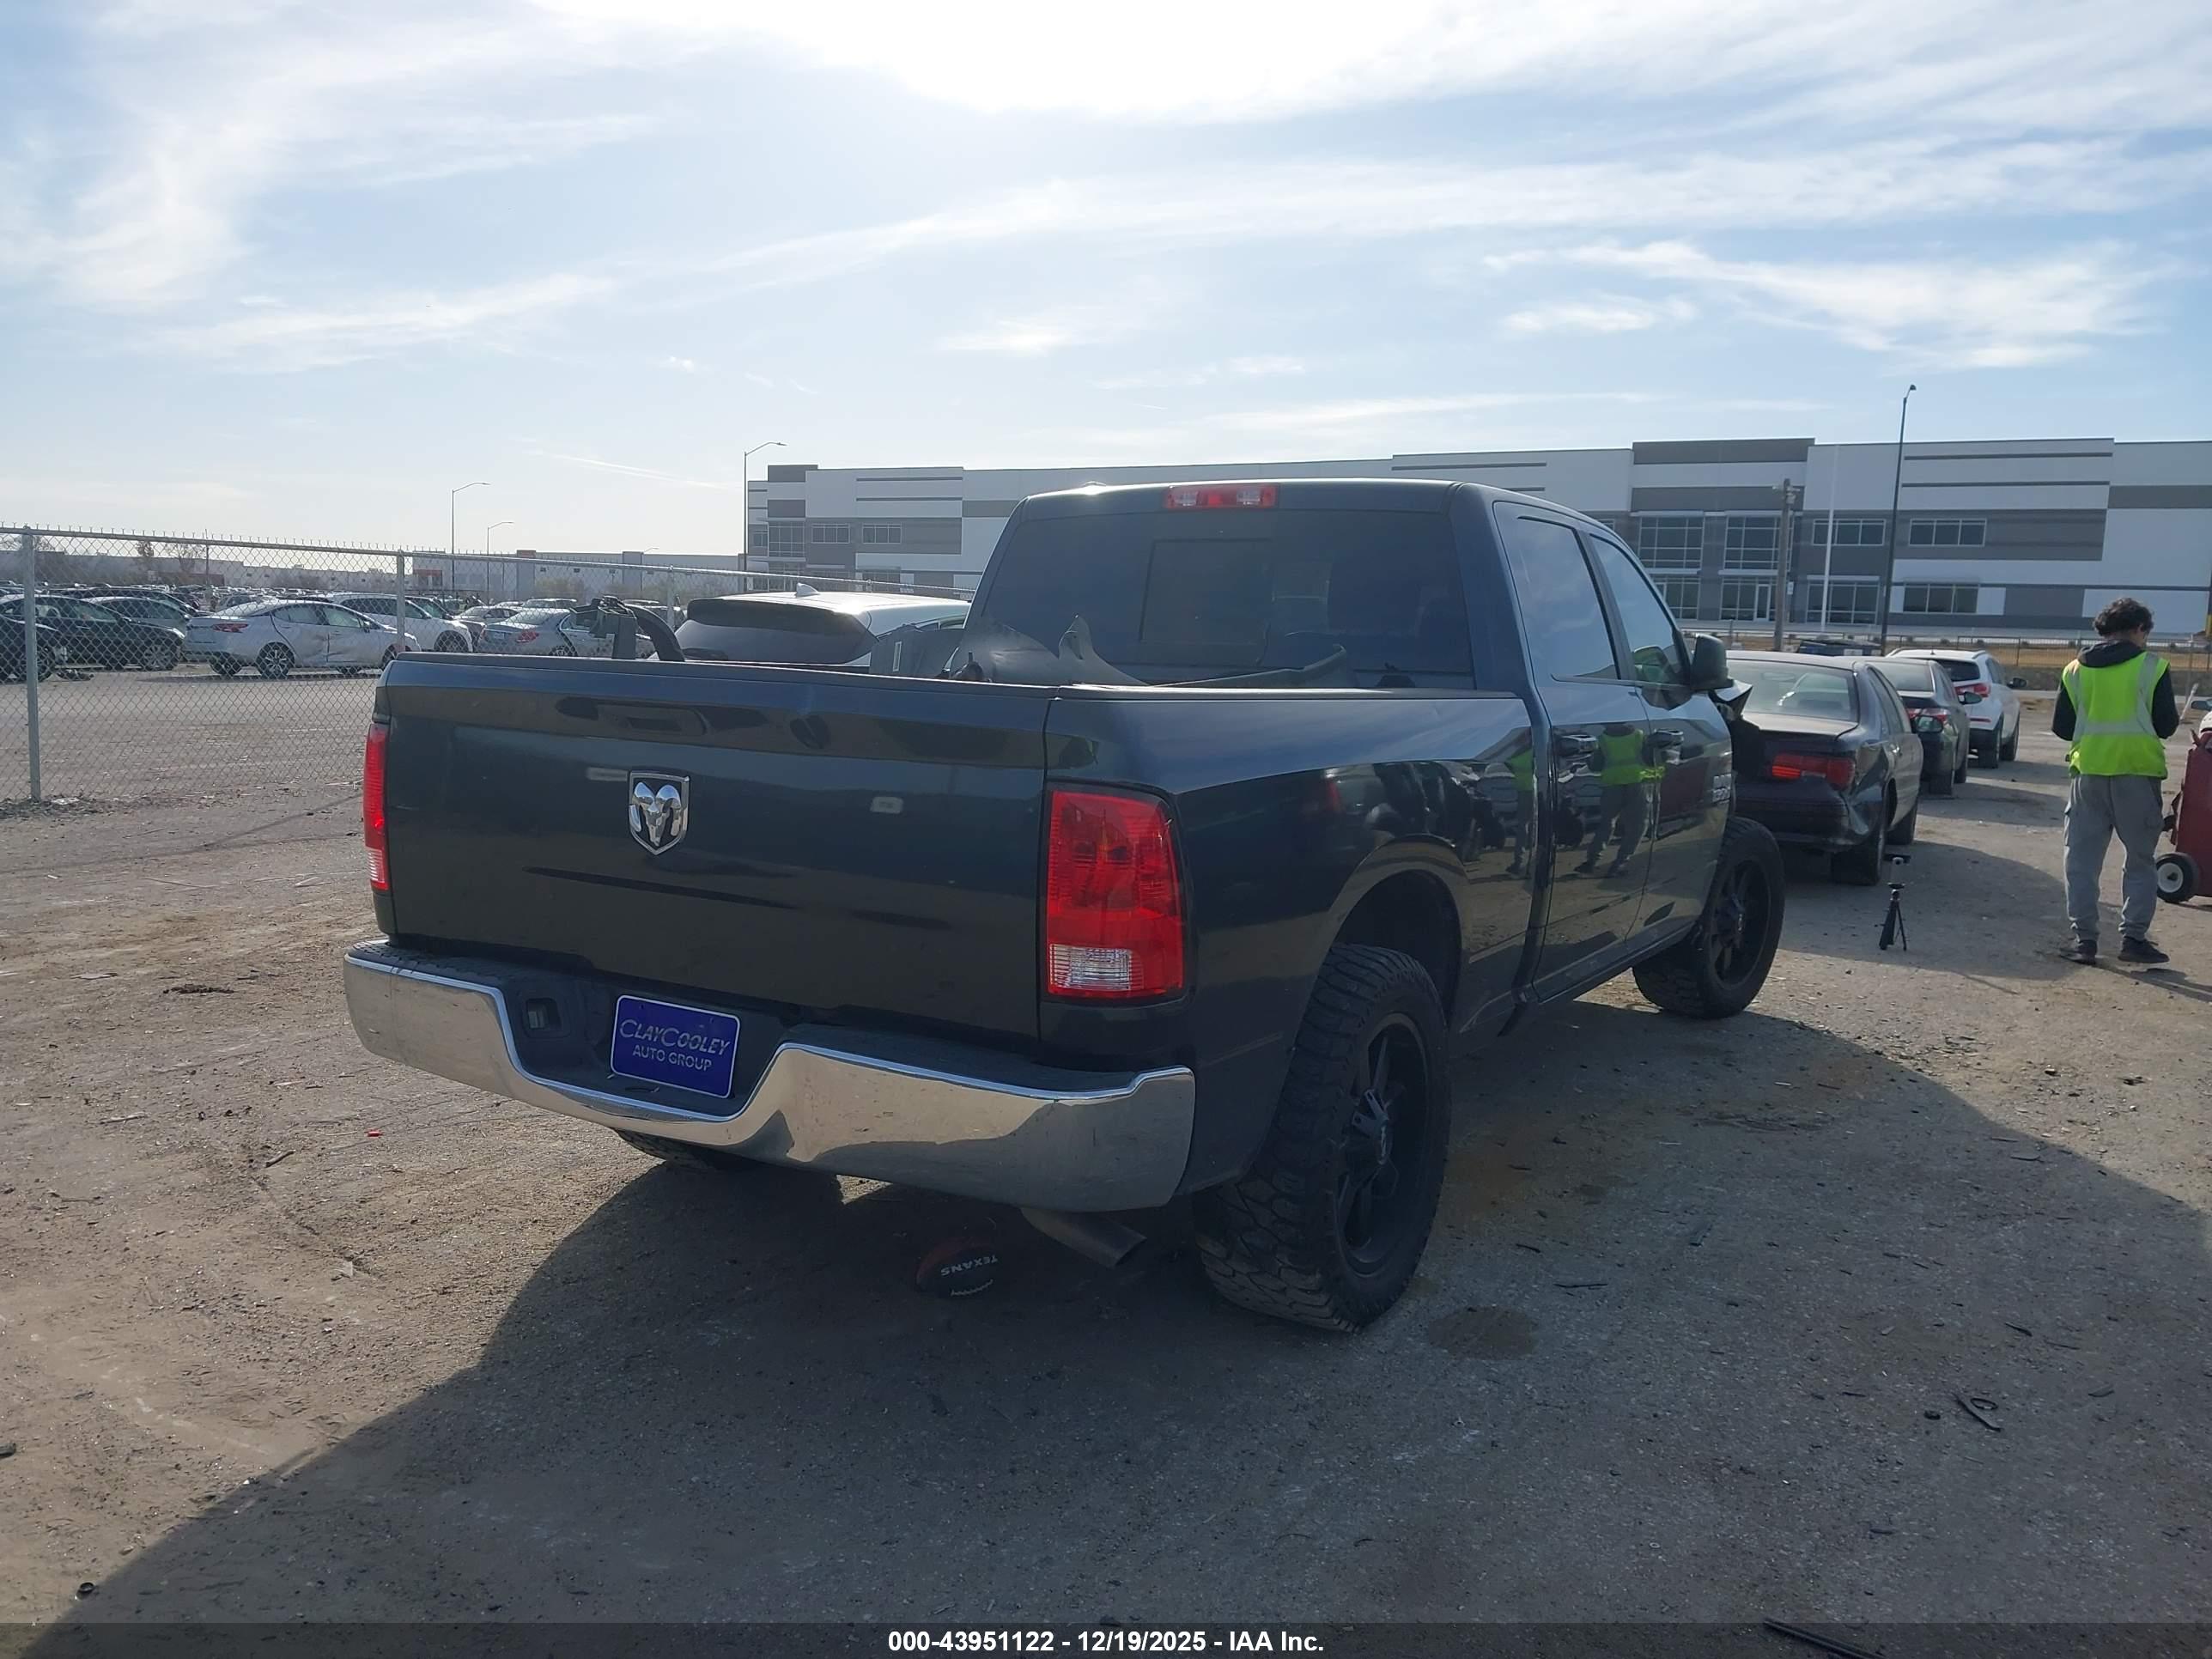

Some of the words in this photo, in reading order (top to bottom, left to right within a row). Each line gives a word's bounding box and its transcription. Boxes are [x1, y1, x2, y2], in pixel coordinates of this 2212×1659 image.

[632, 1044, 665, 1061] AUTO
[668, 1052, 712, 1072] GROUP
[940, 1255, 998, 1276] TEXANS
